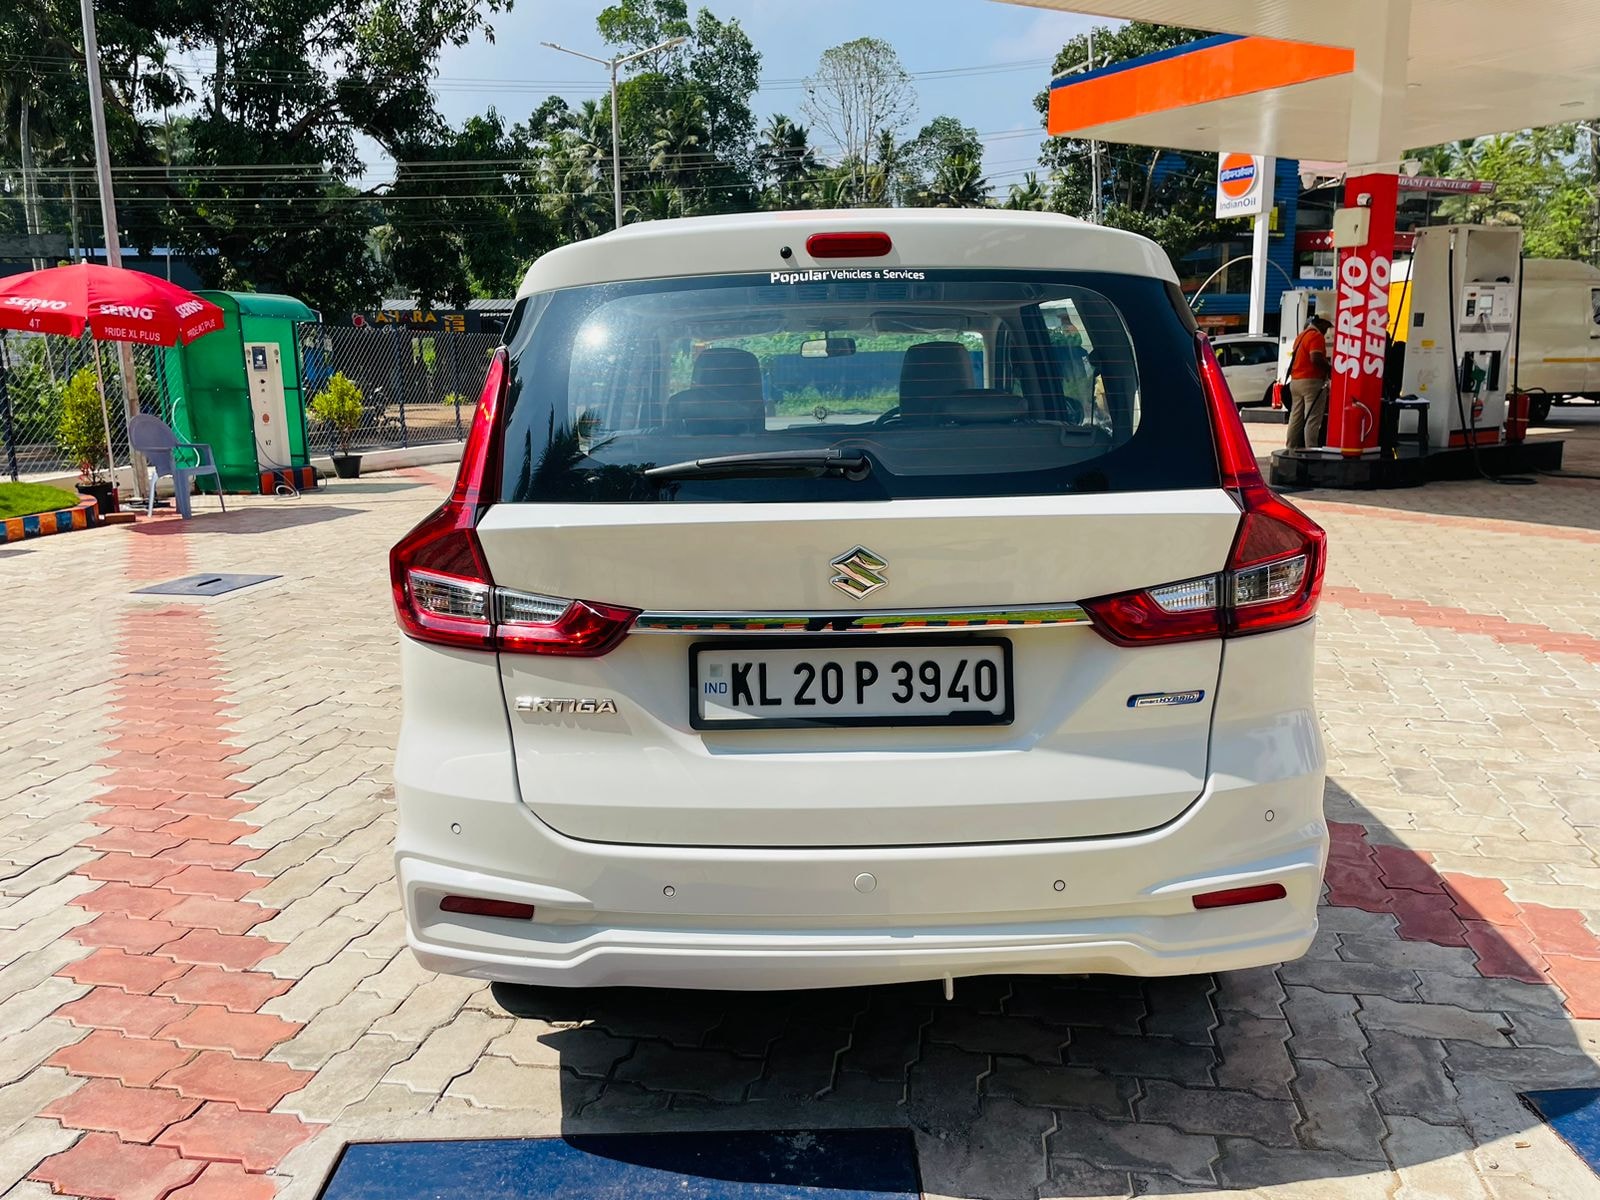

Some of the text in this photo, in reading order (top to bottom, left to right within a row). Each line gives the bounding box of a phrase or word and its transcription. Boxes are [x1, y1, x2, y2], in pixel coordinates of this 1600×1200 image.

[1220, 197, 1256, 210] IndianOil
[770, 268, 925, 284] Popular Vehicles & Services
[4, 297, 68, 313] SERVO
[100, 304, 153, 320] SERVO
[175, 300, 204, 319] SERVO
[29, 318, 41, 328] 4T
[1334, 256, 1368, 380] SERVO
[1363, 256, 1391, 379] SERVO
[104, 326, 161, 342] PRIDE XL PLUS
[704, 658, 998, 707] IND KL 20 P 3940
[513, 696, 618, 714] ERTIGA
